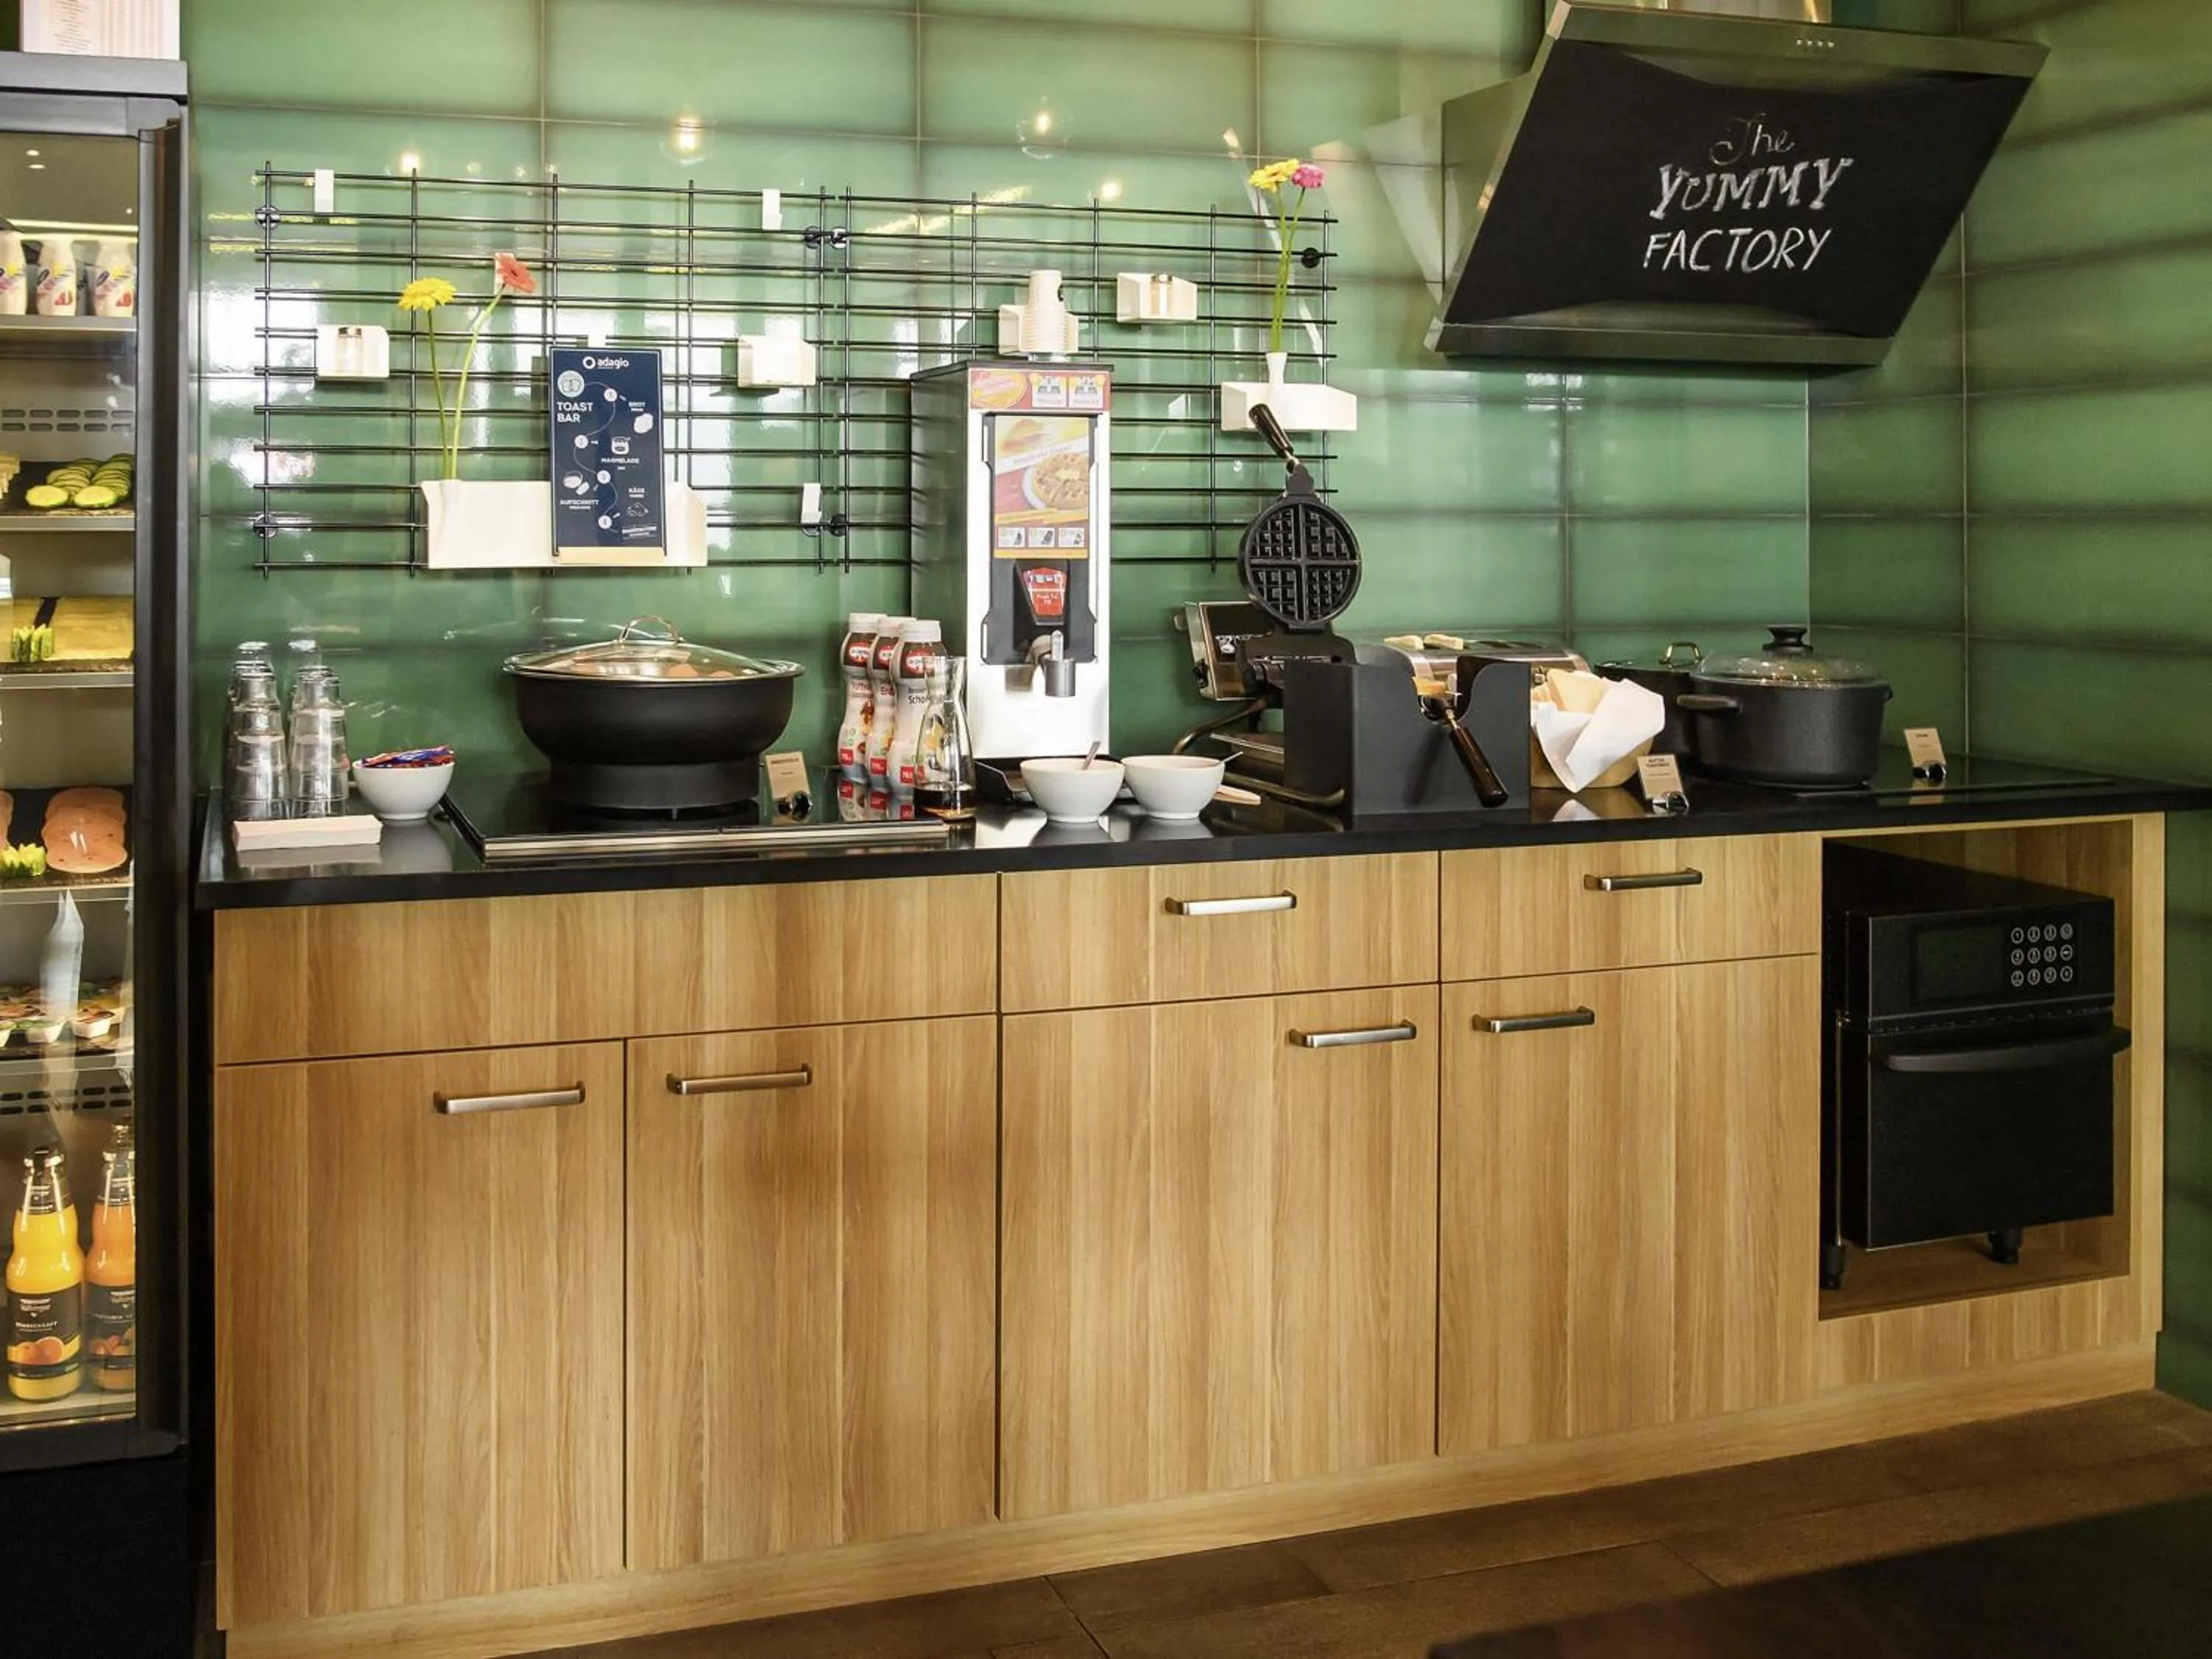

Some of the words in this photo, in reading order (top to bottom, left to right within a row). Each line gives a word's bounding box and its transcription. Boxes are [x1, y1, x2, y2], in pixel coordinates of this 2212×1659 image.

[1708, 113, 1795, 166] The
[1649, 158, 1855, 220] YUMMY
[1643, 227, 1832, 272] FACTORY
[597, 357, 630, 369] adagio
[557, 402, 594, 412] TOAST
[557, 413, 581, 423] BAR
